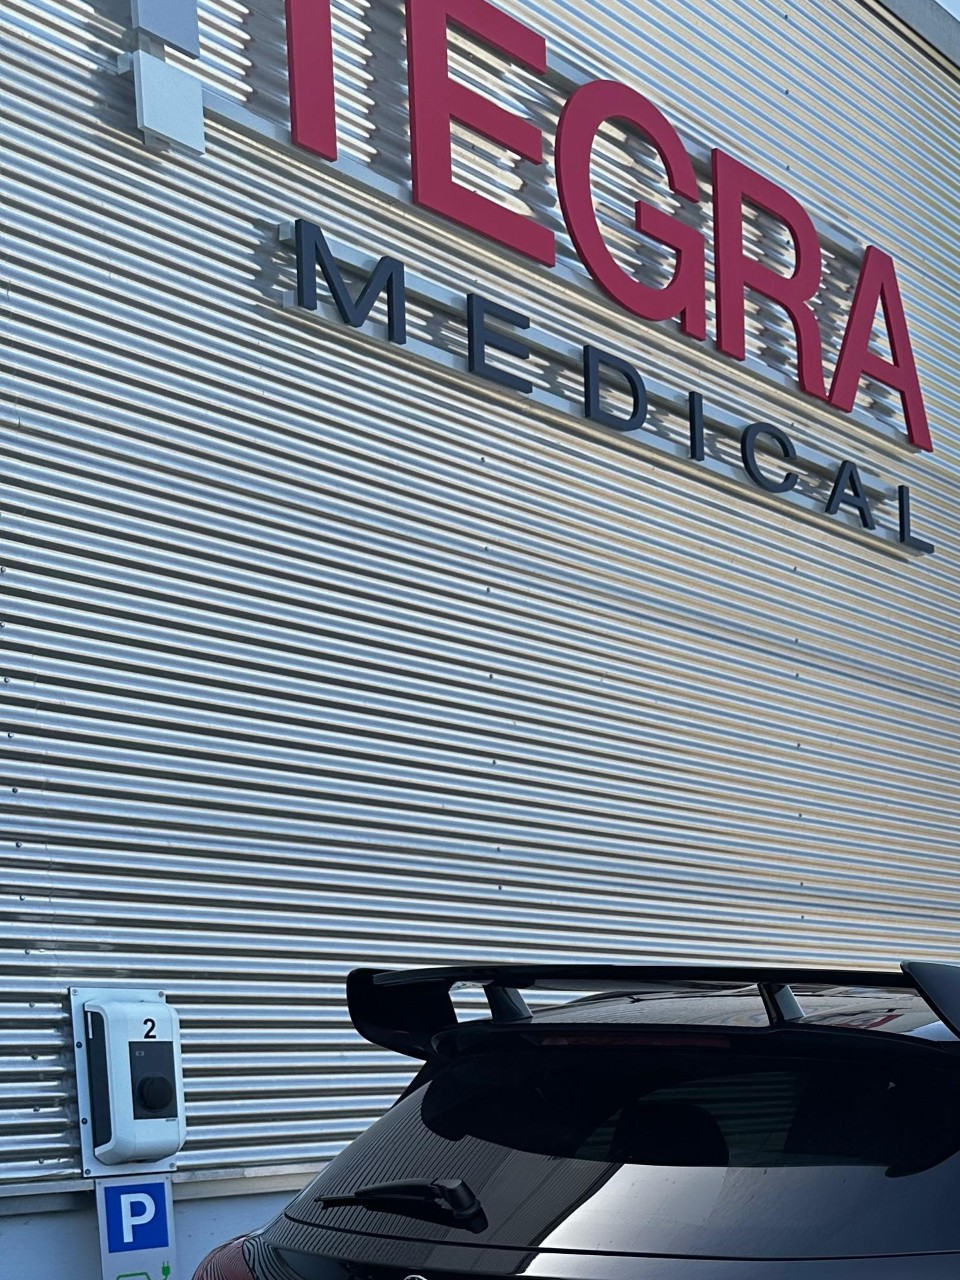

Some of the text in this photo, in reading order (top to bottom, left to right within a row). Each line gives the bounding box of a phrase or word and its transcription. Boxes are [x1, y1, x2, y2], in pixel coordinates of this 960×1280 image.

[294, 218, 934, 553] MEDICAL
[143, 1018, 157, 1040] 2
[120, 1192, 156, 1243] P
